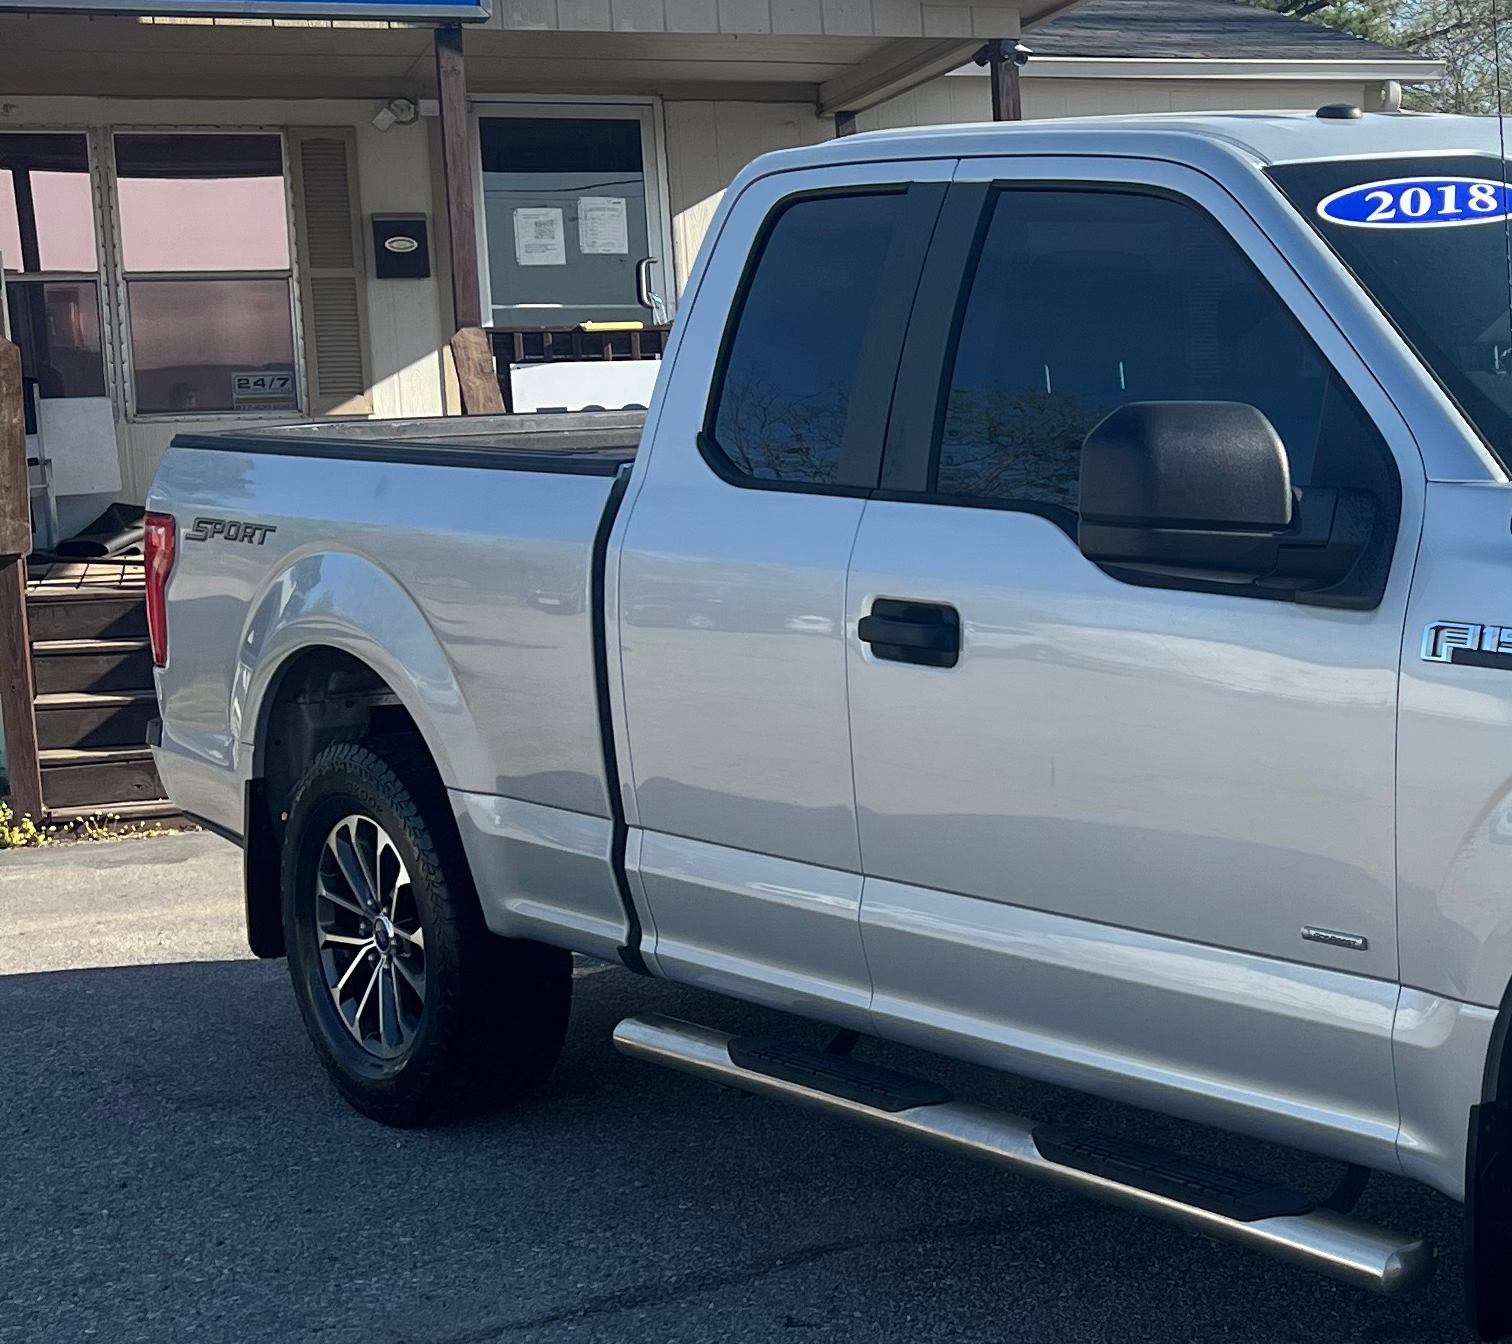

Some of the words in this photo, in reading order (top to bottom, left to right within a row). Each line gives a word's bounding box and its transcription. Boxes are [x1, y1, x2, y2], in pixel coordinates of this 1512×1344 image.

[1364, 183, 1498, 222] 2018
[237, 377, 290, 389] 24/7
[185, 517, 277, 545] SPORT
